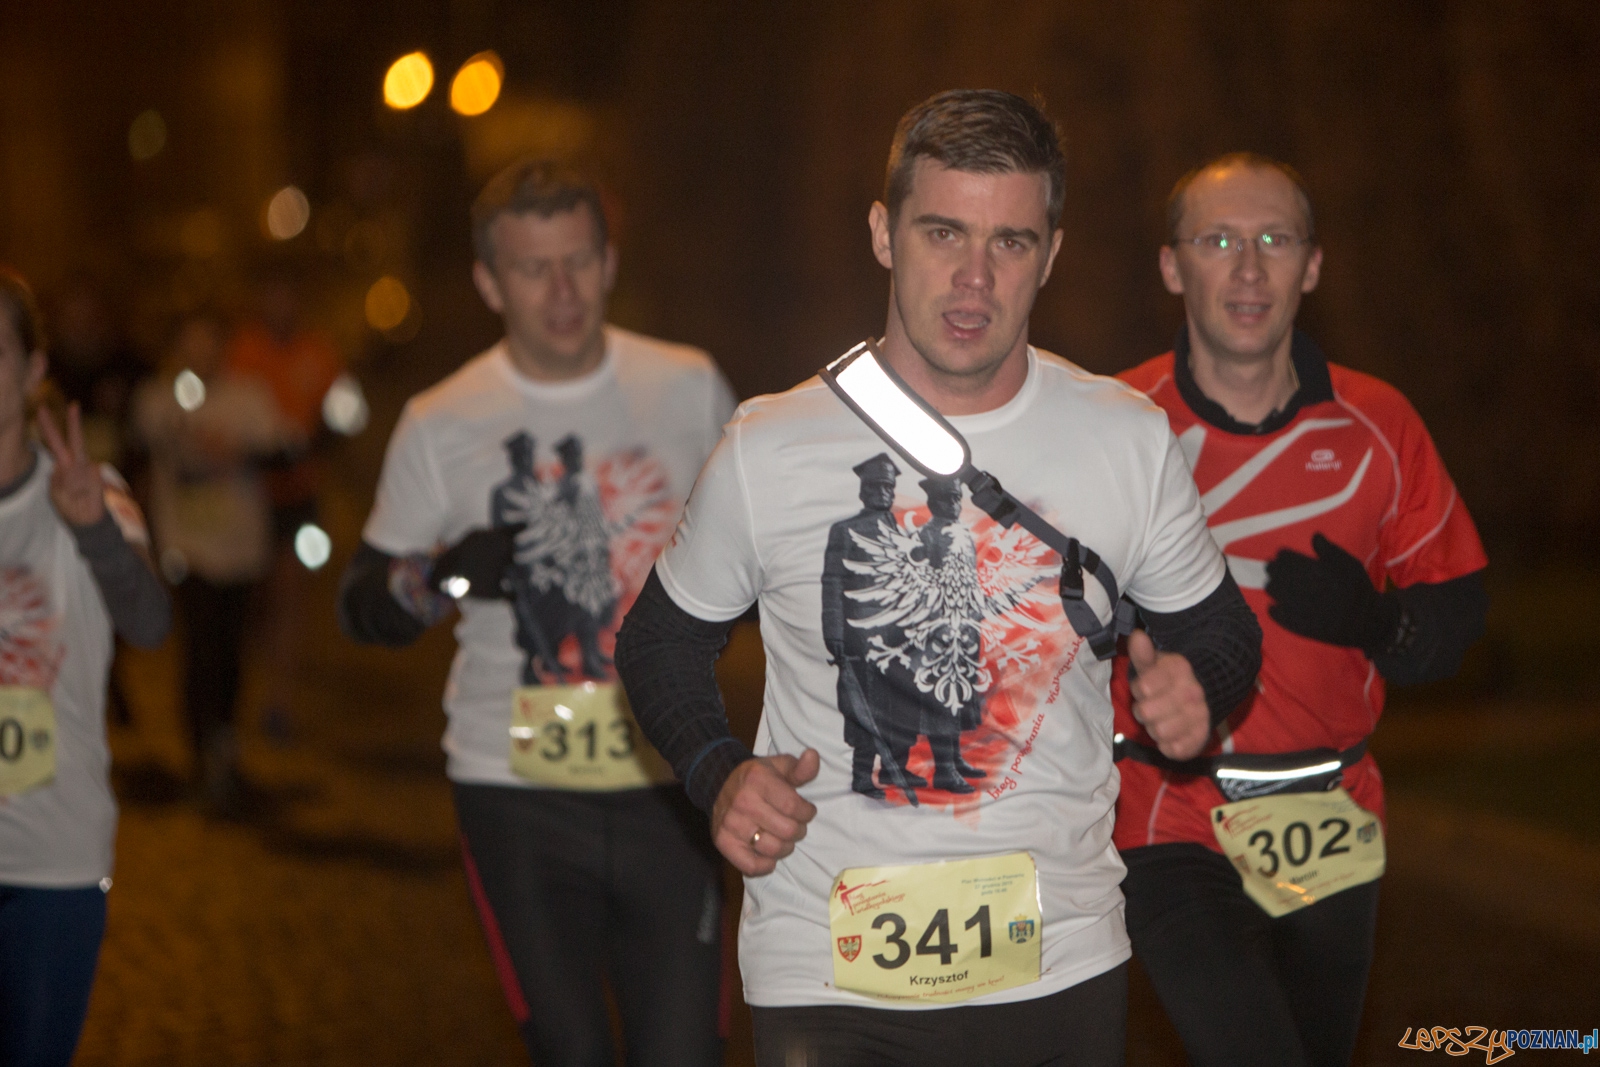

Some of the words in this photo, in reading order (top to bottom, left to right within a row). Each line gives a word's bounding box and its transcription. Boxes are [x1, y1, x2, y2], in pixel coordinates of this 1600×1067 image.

[541, 720, 635, 762] 313
[987, 776, 1017, 800] bieg
[1248, 817, 1351, 879] 302
[871, 905, 992, 969] 341
[909, 970, 968, 987] Krzysztof
